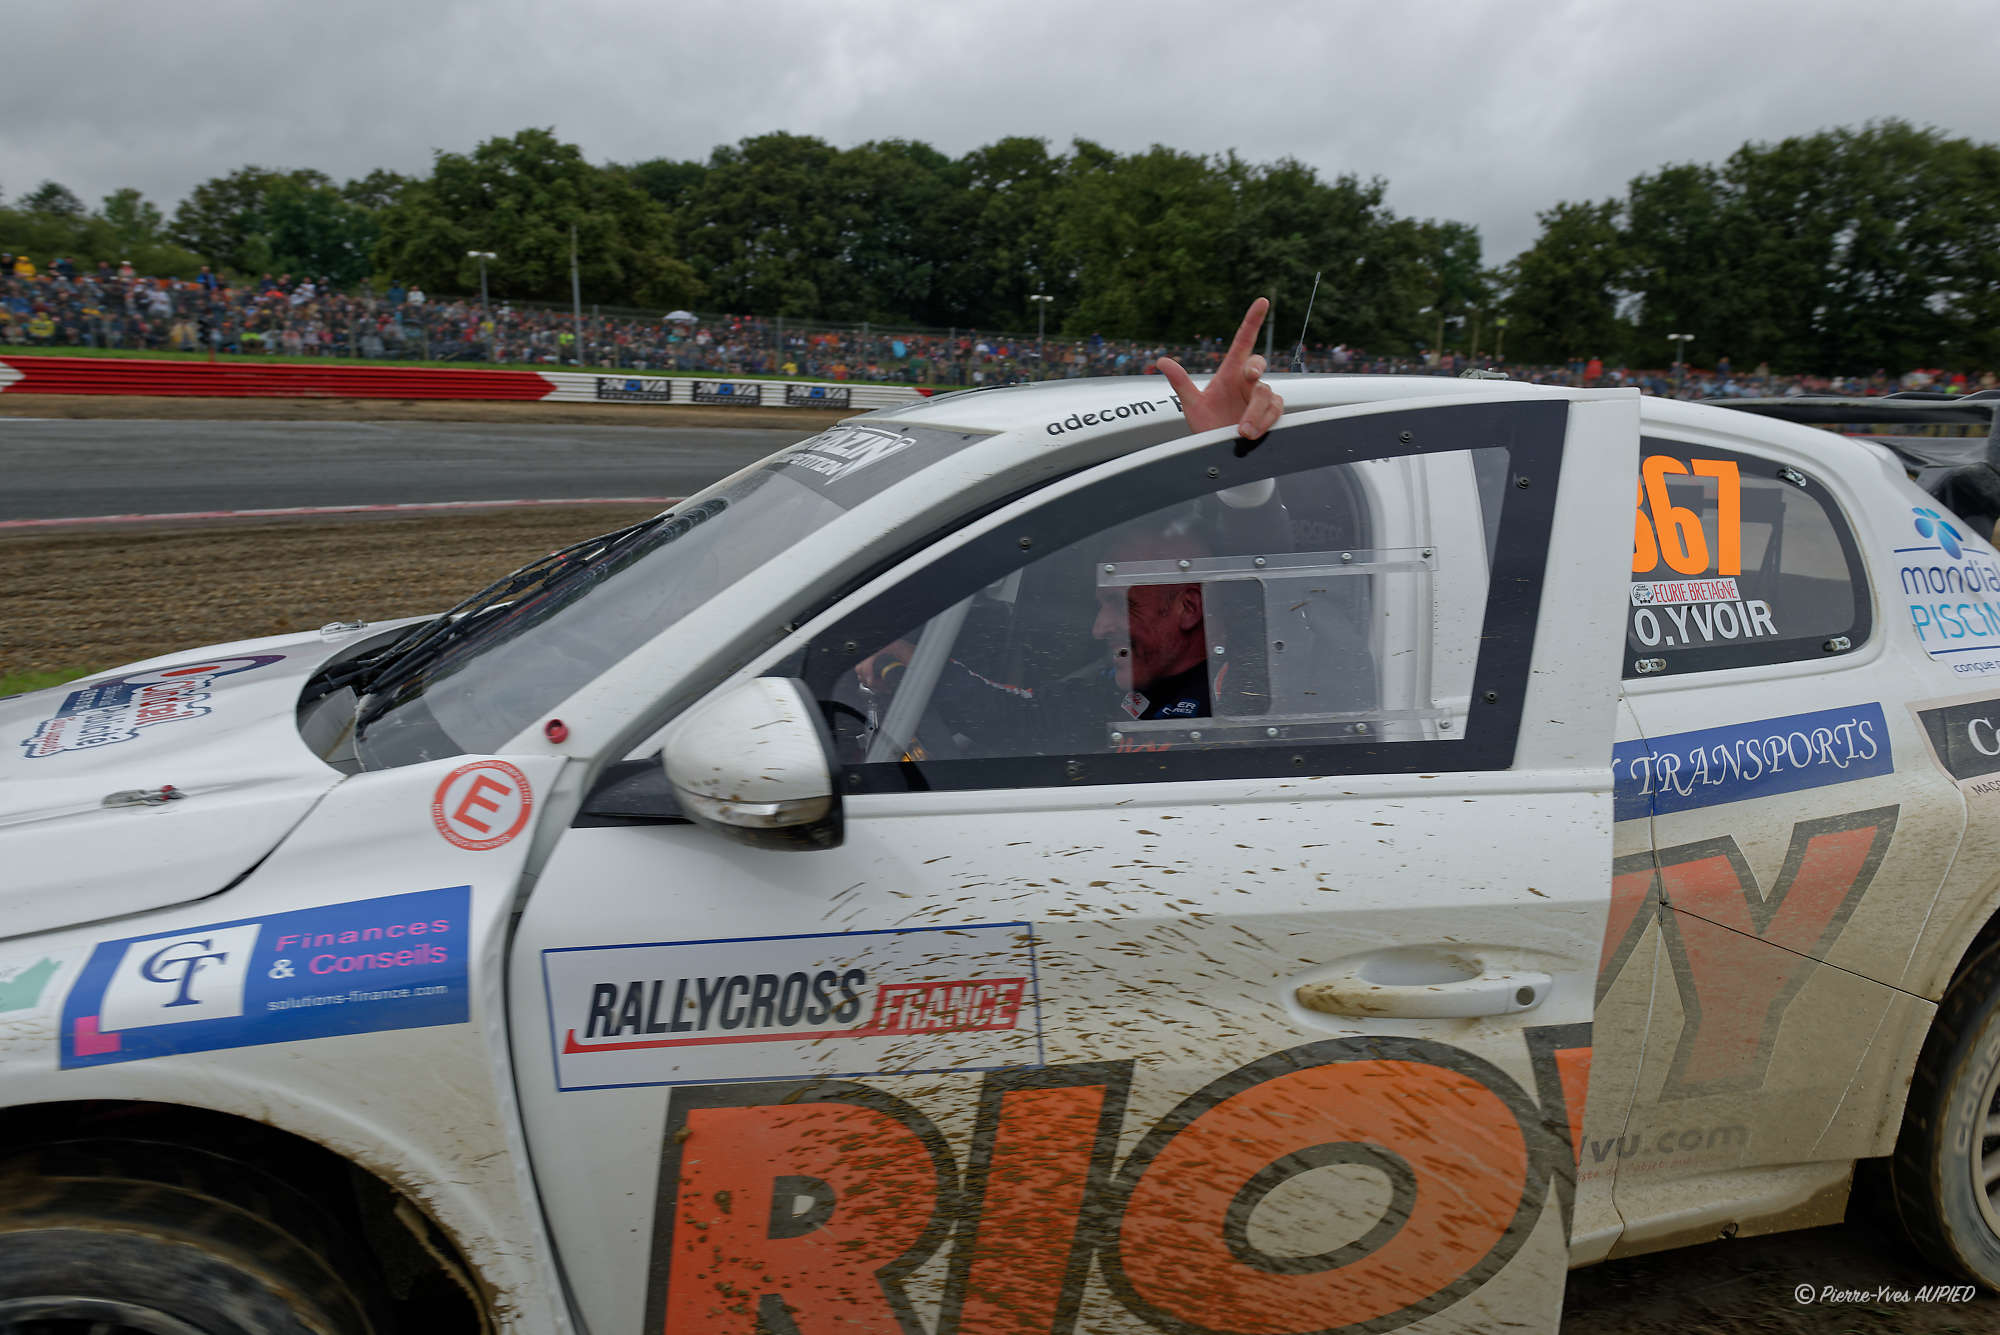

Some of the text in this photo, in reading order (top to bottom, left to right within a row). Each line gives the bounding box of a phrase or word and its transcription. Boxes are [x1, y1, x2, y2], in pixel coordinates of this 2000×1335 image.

[1653, 583, 1690, 602] ECURIE
[1688, 580, 1737, 601] BRETAGNE
[1634, 599, 1778, 647] O.YVOIR
[1968, 717, 2000, 756] C
[1630, 718, 1878, 796] TRANSPORTS
[453, 774, 512, 834] E
[275, 919, 450, 952] Finances
[267, 943, 449, 980] & Conseils
[266, 985, 449, 1011] solutions-finance.com
[586, 968, 1017, 1039] RALLYCROSS FRANCE
